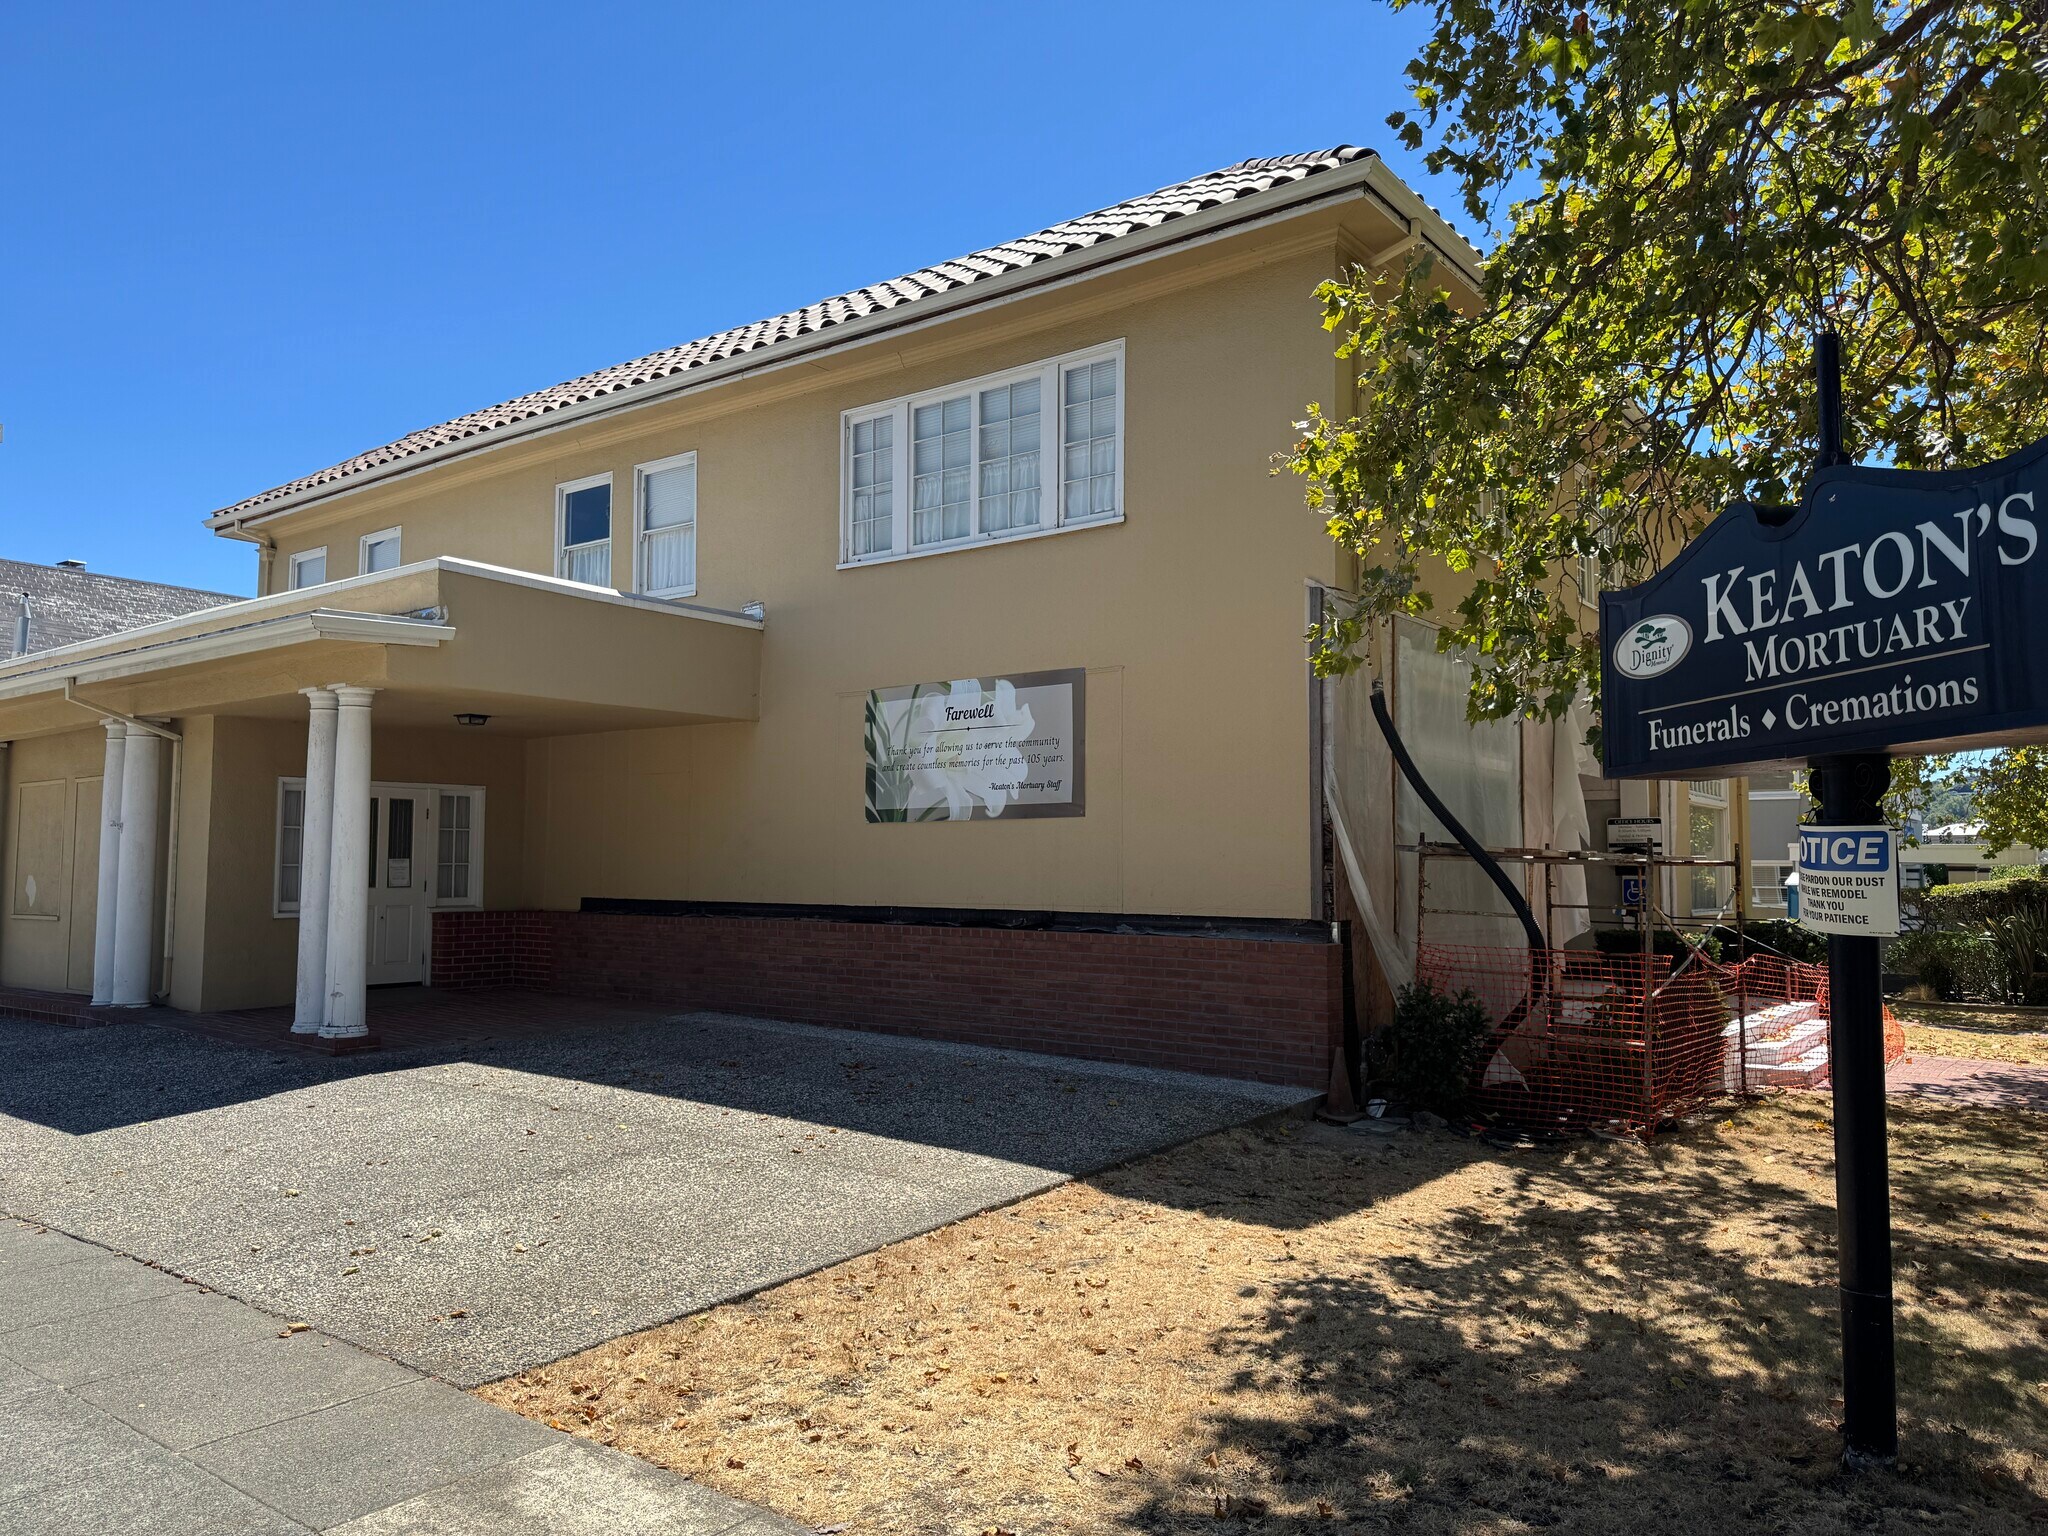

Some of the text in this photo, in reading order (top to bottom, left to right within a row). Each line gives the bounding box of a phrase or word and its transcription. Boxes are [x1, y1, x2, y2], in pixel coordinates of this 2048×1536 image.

[1700, 490, 2039, 644] KEATON'S
[1744, 596, 1972, 683] MORTUARY
[1630, 646, 1673, 671] Dignity
[945, 703, 995, 722] Farewell
[1648, 674, 1979, 751] Funerals Cremations
[887, 736, 1060, 759] Thank you for allowing us to serve the community
[881, 760, 895, 772] and
[895, 763, 916, 772] create
[917, 758, 947, 770] countless
[948, 757, 980, 768] memories
[981, 754, 994, 771] for
[995, 753, 1006, 766] the
[1005, 755, 1024, 769] past
[1027, 753, 1041, 764] 105
[1015, 781, 1045, 792] Mortuary
[1046, 779, 1063, 792] Staff
[1800, 835, 1884, 865] OTICE
[1805, 874, 1830, 886] PARDON
[1831, 876, 1853, 887] OUR
[1855, 877, 1885, 887] DUST
[1811, 886, 1821, 897] WE
[1821, 888, 1867, 900] REMODEL
[1807, 898, 1845, 911] THANK YOU
[1808, 909, 1824, 922] YOUR
[1824, 913, 1870, 925] PATIENCE
